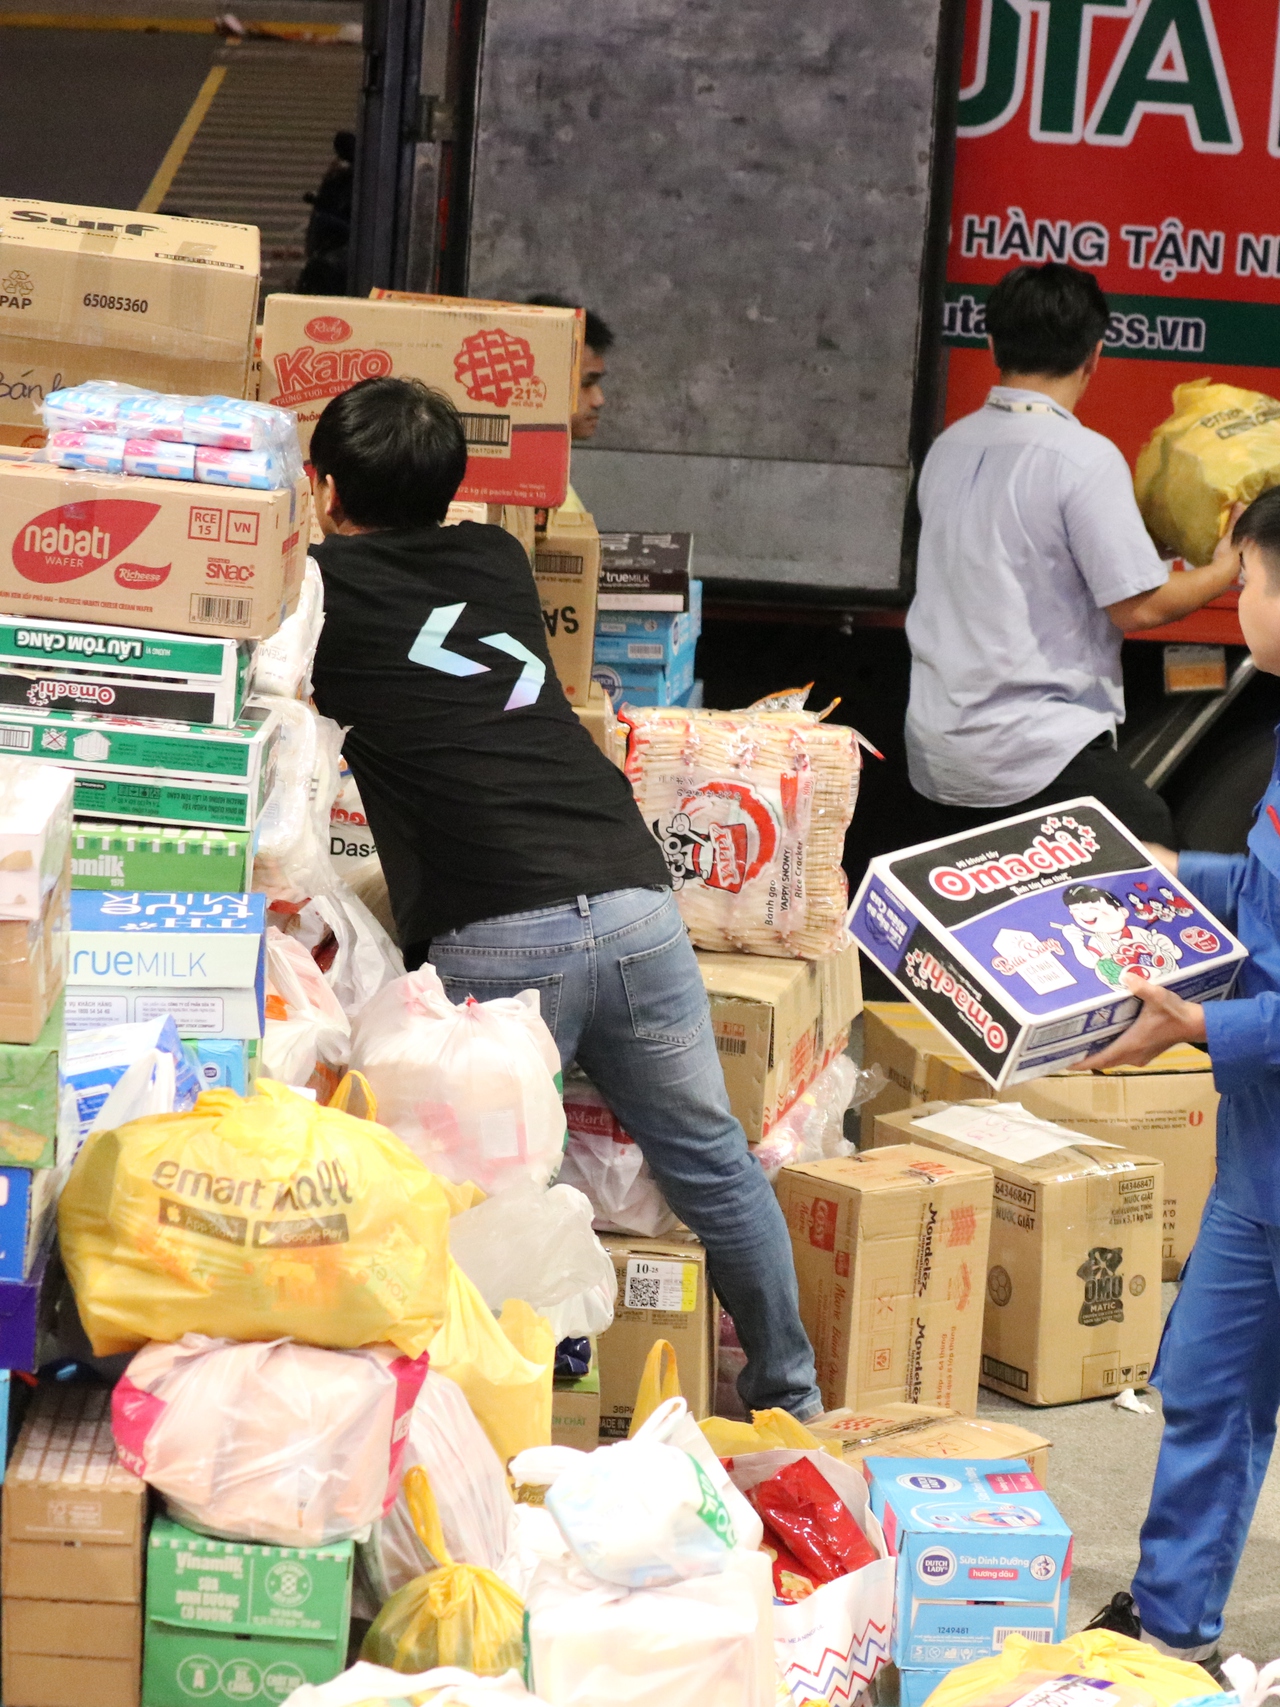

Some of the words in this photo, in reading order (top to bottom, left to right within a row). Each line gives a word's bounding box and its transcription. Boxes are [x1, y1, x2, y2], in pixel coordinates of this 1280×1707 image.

[10, 210, 163, 237] Surf
[961, 205, 1108, 265] HÀNG
[1121, 217, 1224, 282] TẬN
[0, 295, 33, 310] PAP
[83, 293, 149, 313] 65085360
[274, 346, 392, 395] Karo
[194, 512, 217, 525] RCE
[233, 521, 251, 533] VN
[198, 525, 211, 535] 15
[24, 523, 110, 560] nabati
[45, 556, 84, 568] WAFER
[119, 568, 161, 582] Richeese
[16, 629, 66, 652] CÀNG
[68, 635, 105, 657] TÔM
[106, 638, 143, 662] LẨU
[38, 681, 116, 705] Omachi
[711, 823, 739, 886] YAPPY
[929, 830, 1093, 901] Omachi
[102, 892, 248, 905] MILK
[100, 904, 253, 919] true
[160, 917, 247, 928] TH
[73, 950, 207, 977] rueMILK
[918, 952, 1008, 1054] Omachi
[152, 1159, 266, 1211] emart
[994, 1182, 1033, 1205] 64346847
[1121, 1179, 1152, 1191] 64346847
[1017, 1213, 1036, 1233] GIẶT
[280, 1228, 320, 1243] Google
[322, 1226, 344, 1241] Play
[1085, 1275, 1123, 1303] OMO
[833, 1283, 846, 1320] Marie
[1090, 1302, 1116, 1313] MATIC
[959, 1555, 978, 1565] Sữa
[978, 1556, 999, 1566] Dinh
[1000, 1556, 1030, 1567] Dưỡng
[973, 1569, 998, 1579] hương
[937, 1626, 969, 1634] 1249481
